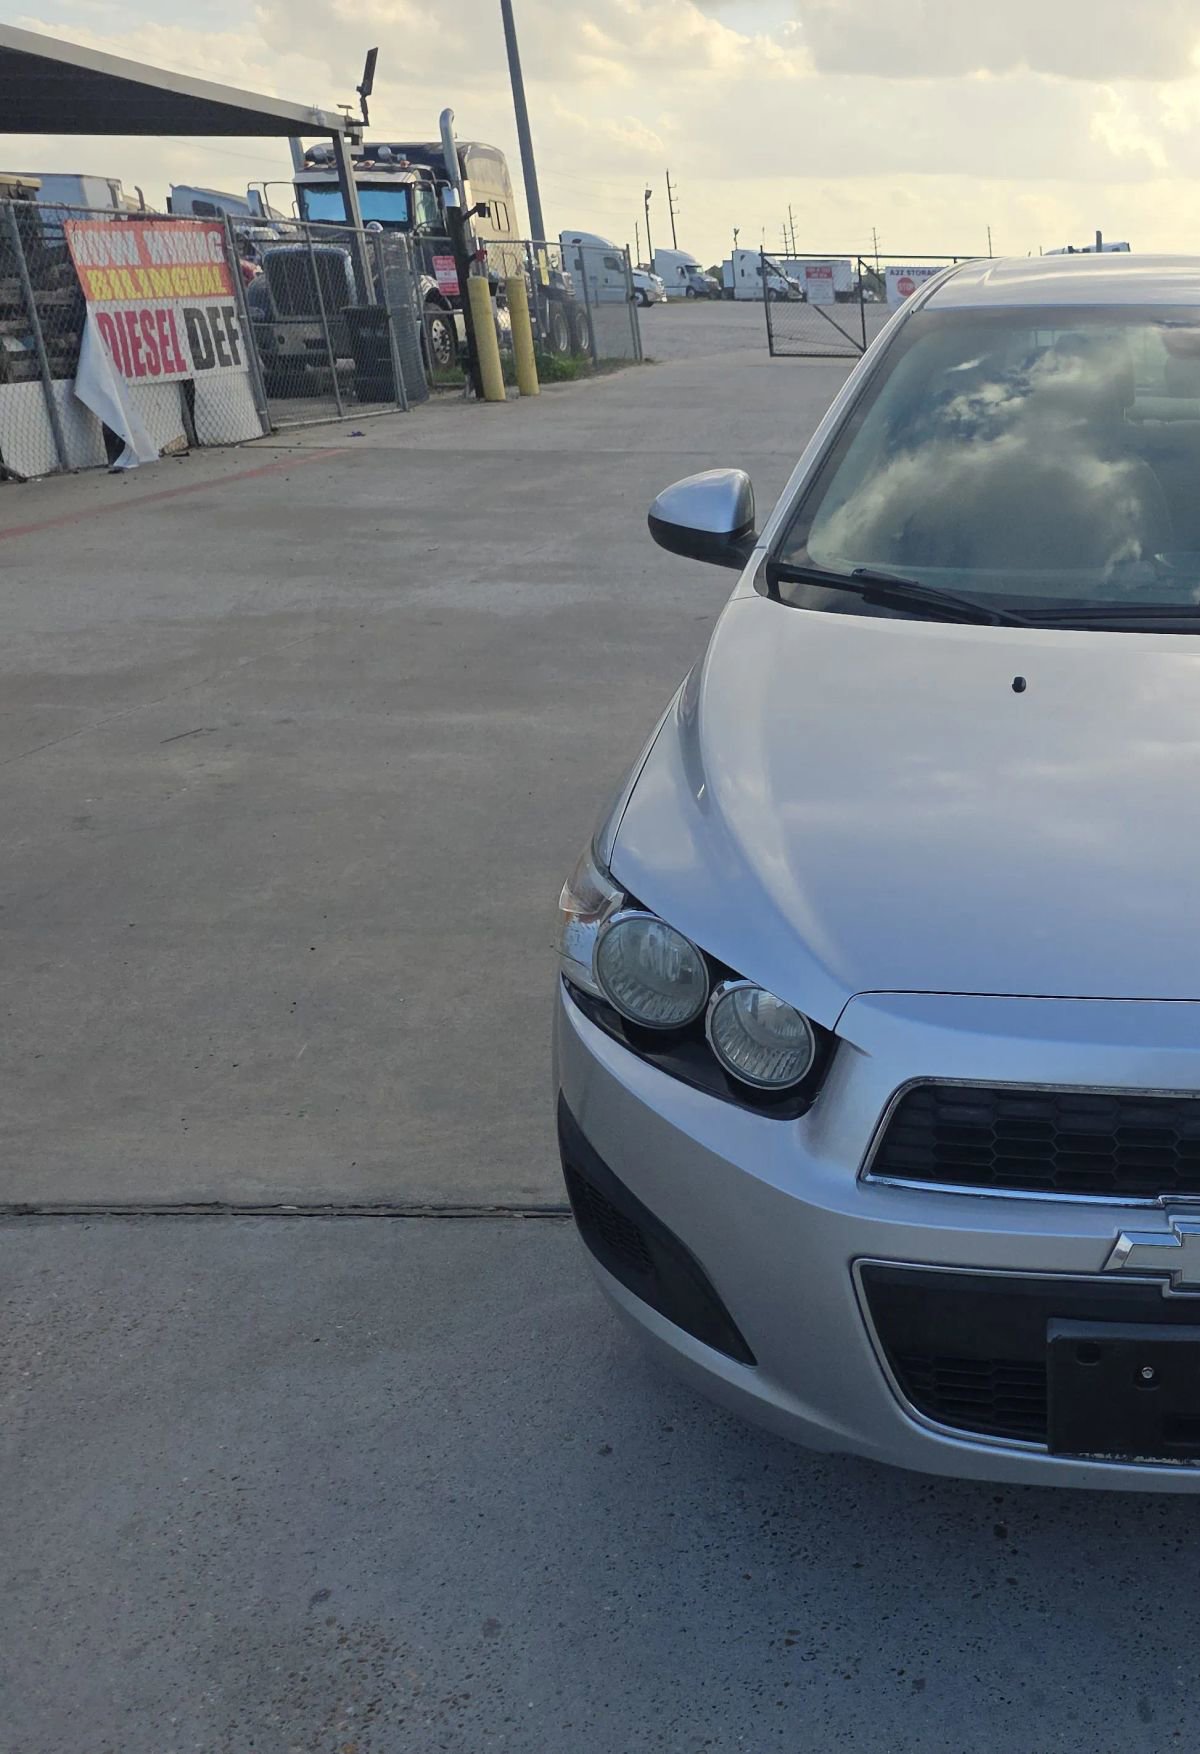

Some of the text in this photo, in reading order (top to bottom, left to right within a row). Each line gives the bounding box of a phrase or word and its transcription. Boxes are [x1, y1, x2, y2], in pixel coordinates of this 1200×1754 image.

[72, 230, 141, 266] NOW
[86, 266, 228, 300] BILINGUAL
[95, 306, 241, 378] DIESEL DEF
